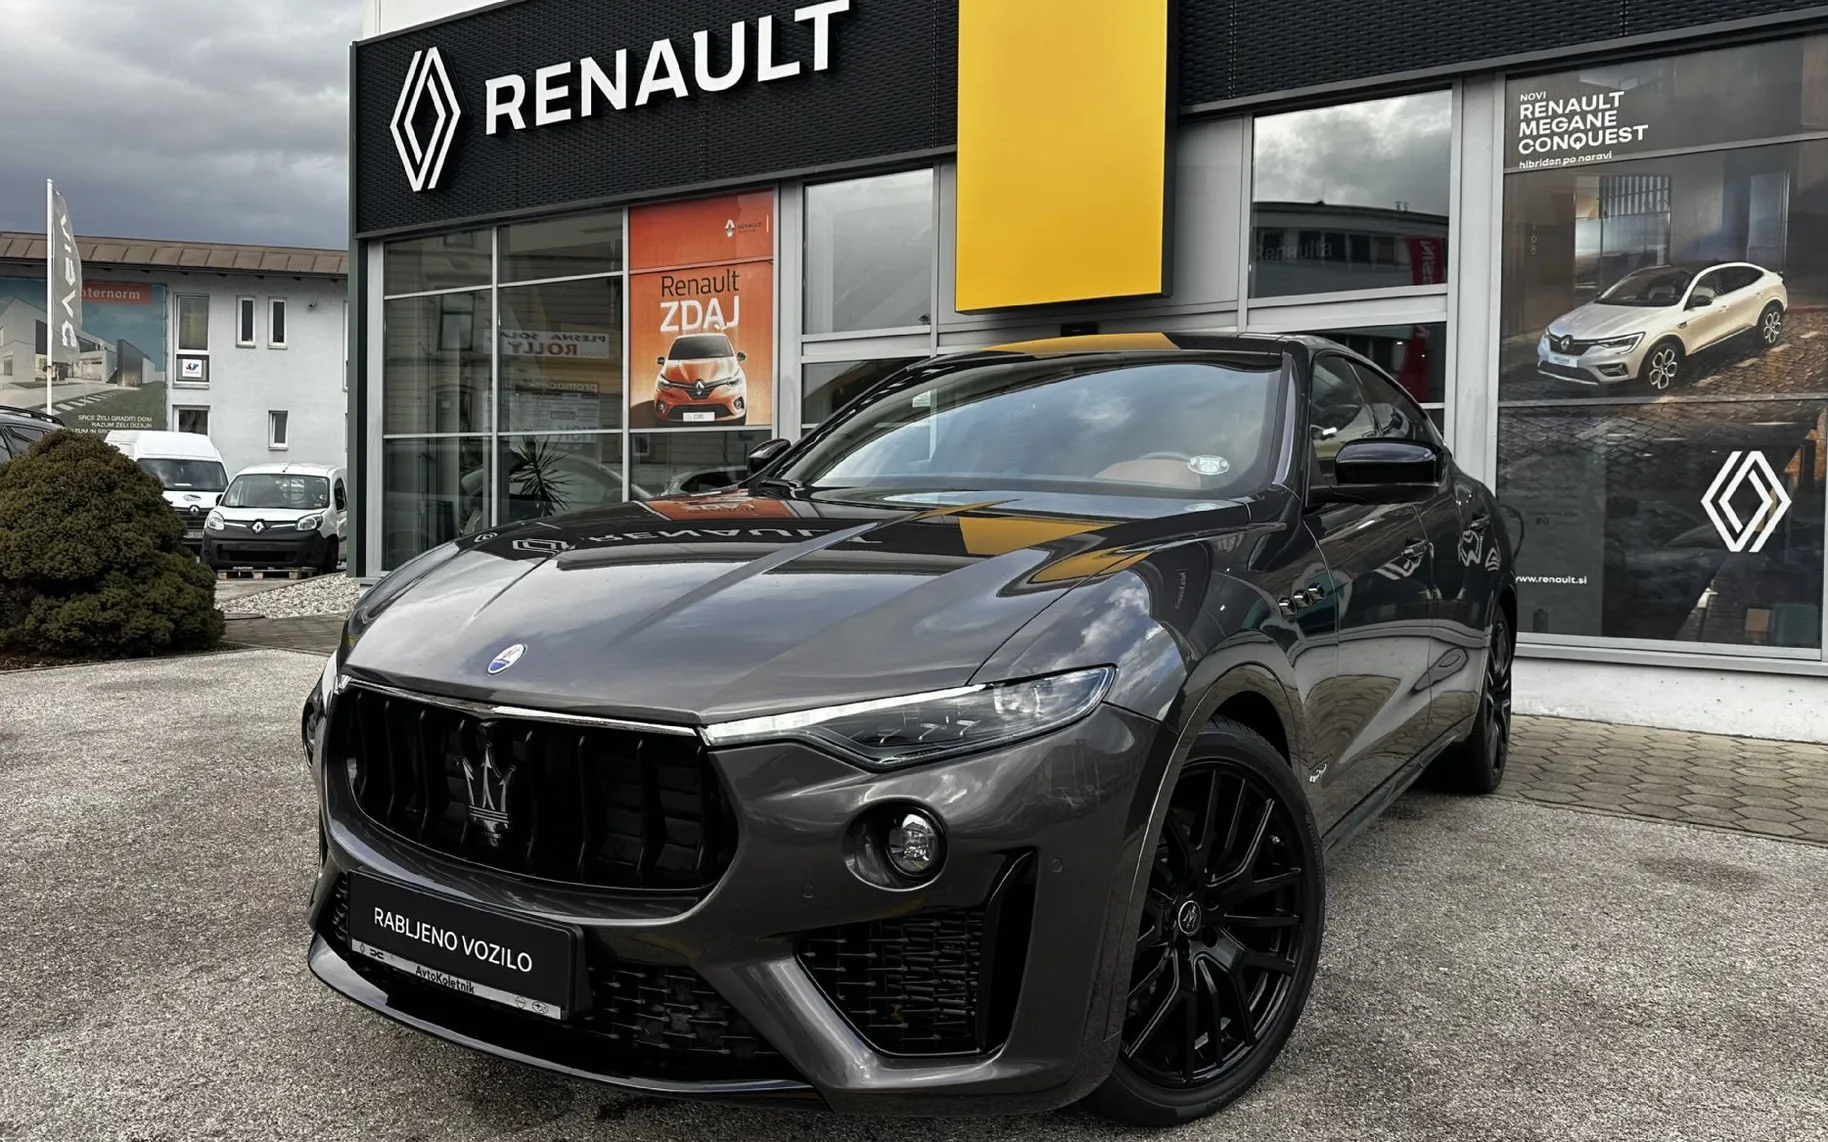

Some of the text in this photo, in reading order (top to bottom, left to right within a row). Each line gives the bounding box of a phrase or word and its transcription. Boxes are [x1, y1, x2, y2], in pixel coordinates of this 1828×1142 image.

[485, 0, 850, 135] RENAULT
[1520, 91, 1547, 102] NOVI
[1520, 91, 1625, 120] RENAULT
[1519, 110, 1618, 137] MEGANE
[1518, 124, 1649, 155] CONQUEST
[1562, 156, 1577, 166] po
[1578, 150, 1613, 163] naravi
[81, 287, 140, 300] nternorm
[661, 269, 740, 297] Renault
[660, 295, 740, 332] ZDAJ
[374, 907, 533, 972] RABLJENO VOZILO
[415, 965, 475, 994] AvtoKoletnik
